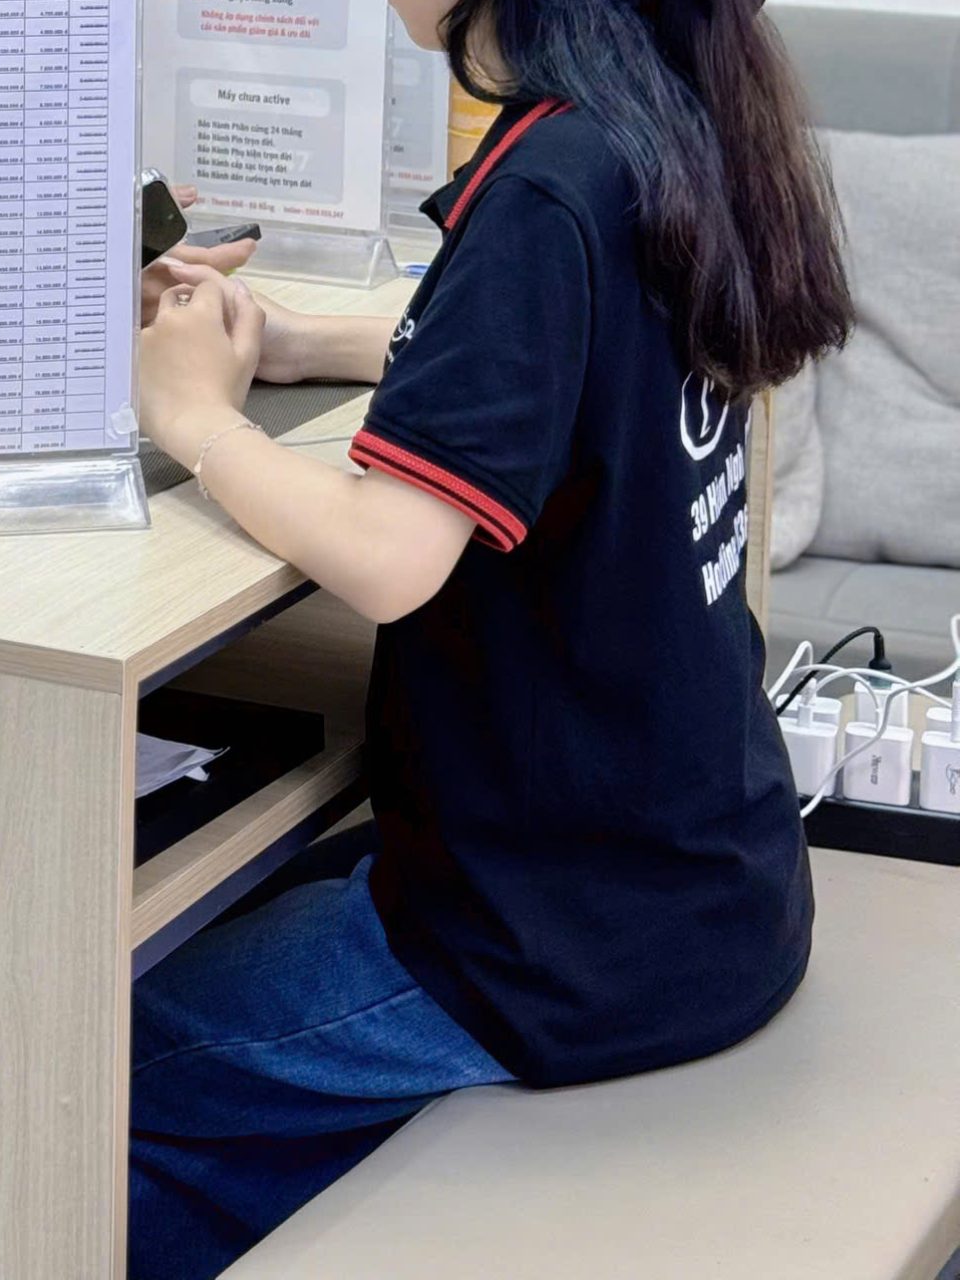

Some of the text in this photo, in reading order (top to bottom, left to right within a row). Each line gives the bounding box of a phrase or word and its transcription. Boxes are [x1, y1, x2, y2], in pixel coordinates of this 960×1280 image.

[218, 89, 290, 105] Máy chưa active
[691, 499, 709, 543] 39
